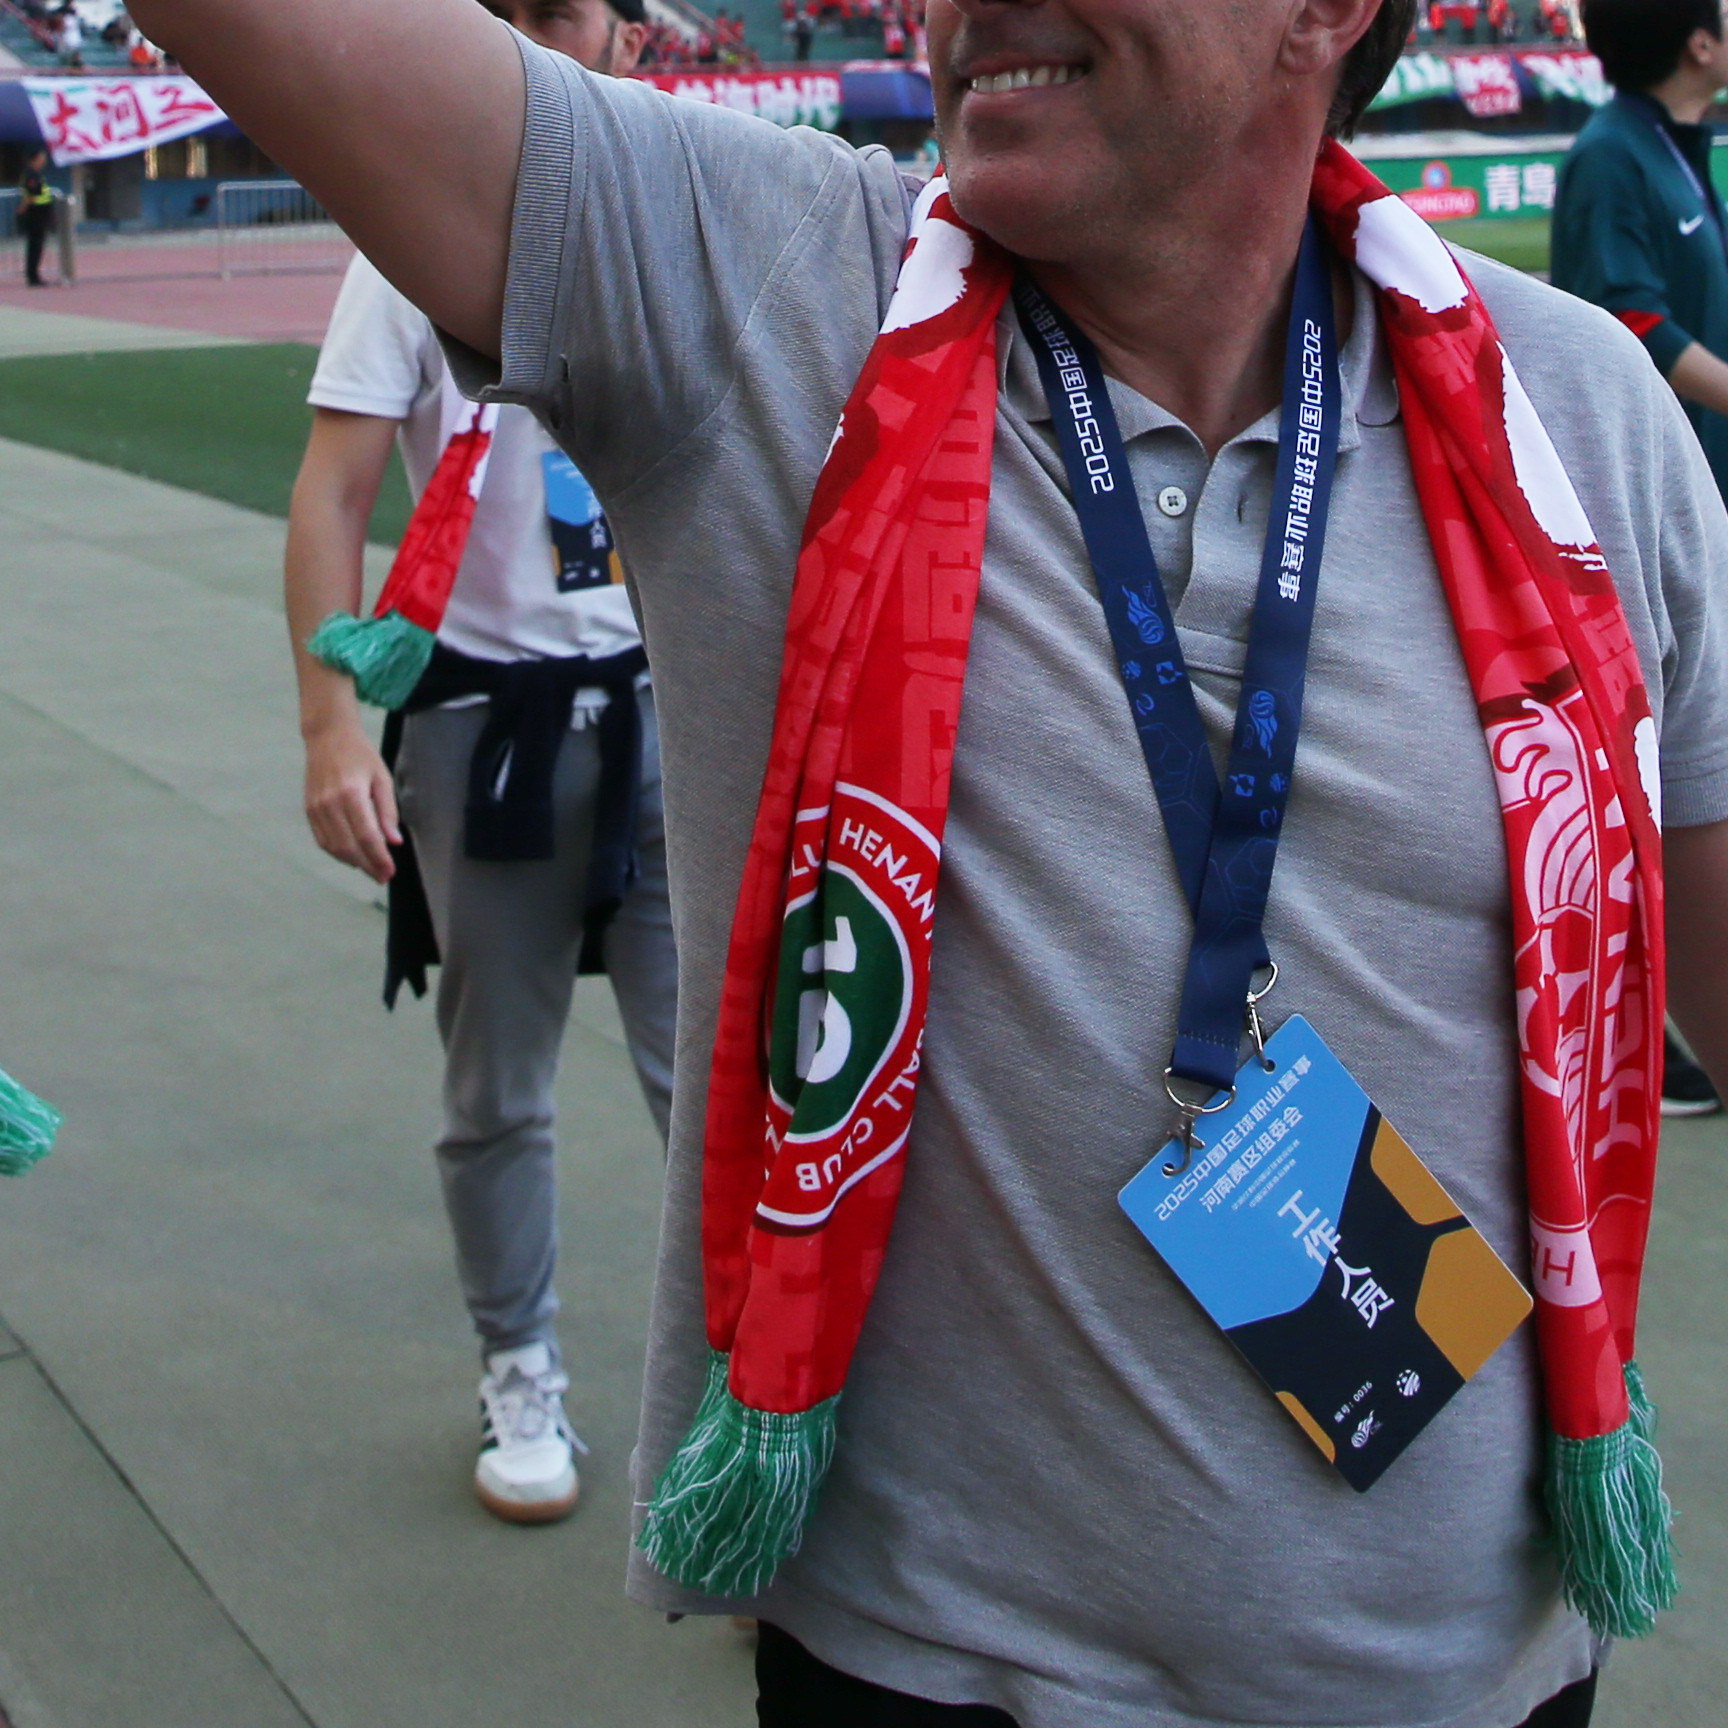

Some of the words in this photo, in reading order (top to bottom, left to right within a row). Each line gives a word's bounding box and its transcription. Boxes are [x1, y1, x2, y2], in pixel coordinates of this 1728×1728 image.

[1277, 318, 1323, 603] 2025中国足球职业赛事
[795, 1116, 874, 1192] CLUB
[1153, 1053, 1313, 1222] 2025中国足球职业赛事
[1198, 1106, 1305, 1214] 河南赛区组委会
[1276, 1188, 1396, 1329] 工作人员
